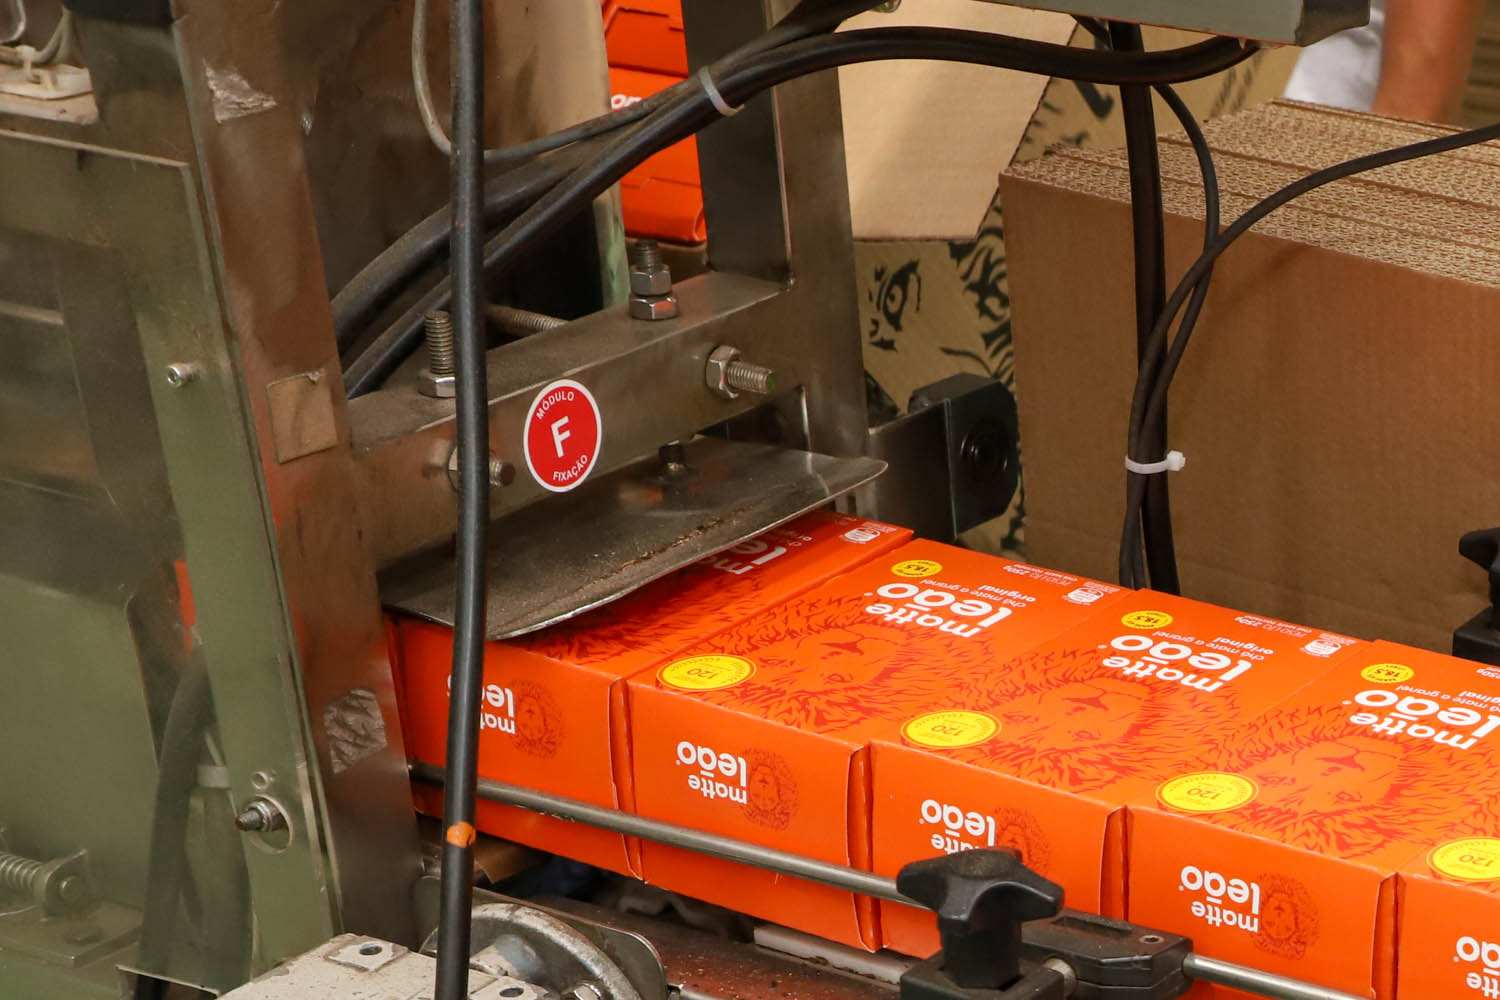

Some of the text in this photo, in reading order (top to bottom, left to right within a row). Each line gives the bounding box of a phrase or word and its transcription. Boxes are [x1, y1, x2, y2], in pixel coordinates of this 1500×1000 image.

[536, 391, 575, 420] MÓDULO
[551, 416, 571, 459] F
[552, 455, 588, 481] FIXAÇÃO
[866, 603, 981, 638] matte
[877, 583, 1012, 627] leão
[1110, 635, 1251, 681] leão
[1213, 637, 1274, 655] original
[1102, 656, 1222, 692] matte
[480, 713, 516, 735] mat
[1350, 713, 1478, 750] matte
[676, 741, 747, 787] leão
[688, 774, 748, 804] matte
[921, 799, 995, 846] leão
[1181, 865, 1260, 914] leão
[1191, 901, 1259, 933] matte
